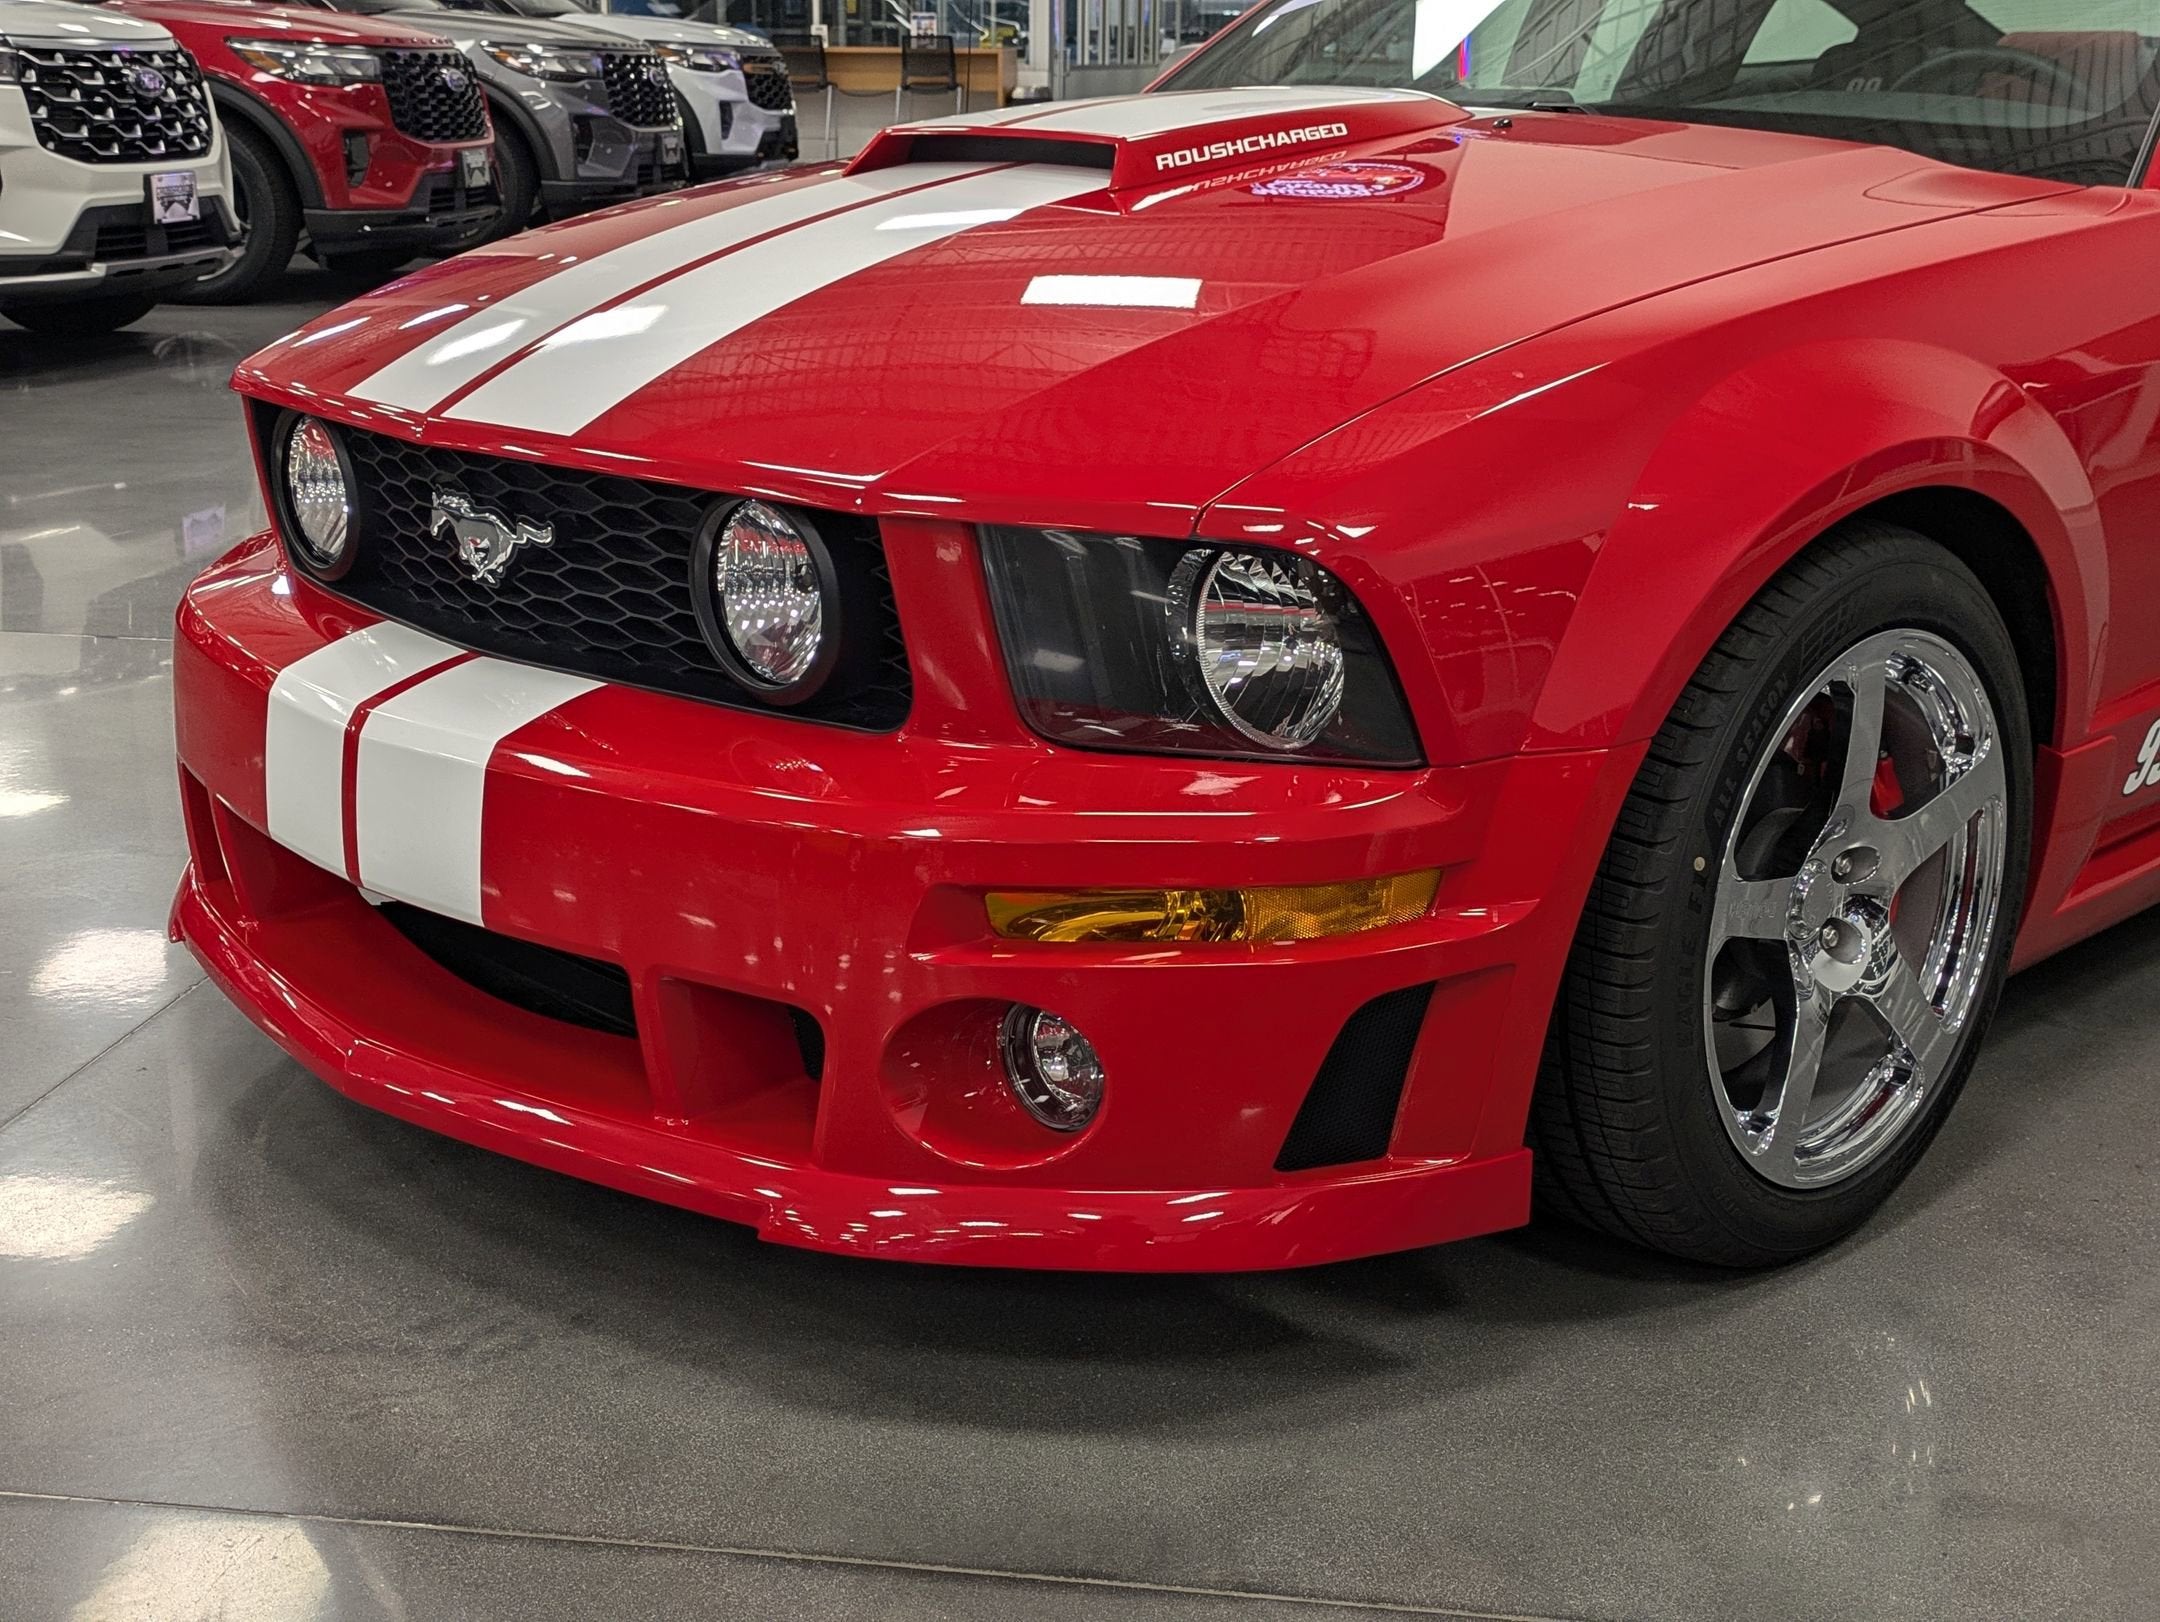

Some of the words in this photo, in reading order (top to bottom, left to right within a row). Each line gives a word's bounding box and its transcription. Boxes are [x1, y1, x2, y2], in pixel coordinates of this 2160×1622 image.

[1155, 122, 1348, 171] ROUSHCHARGED
[1713, 776, 1735, 827] ALL
[1736, 673, 1789, 767] SEASON
[2122, 718, 2160, 795] 9
